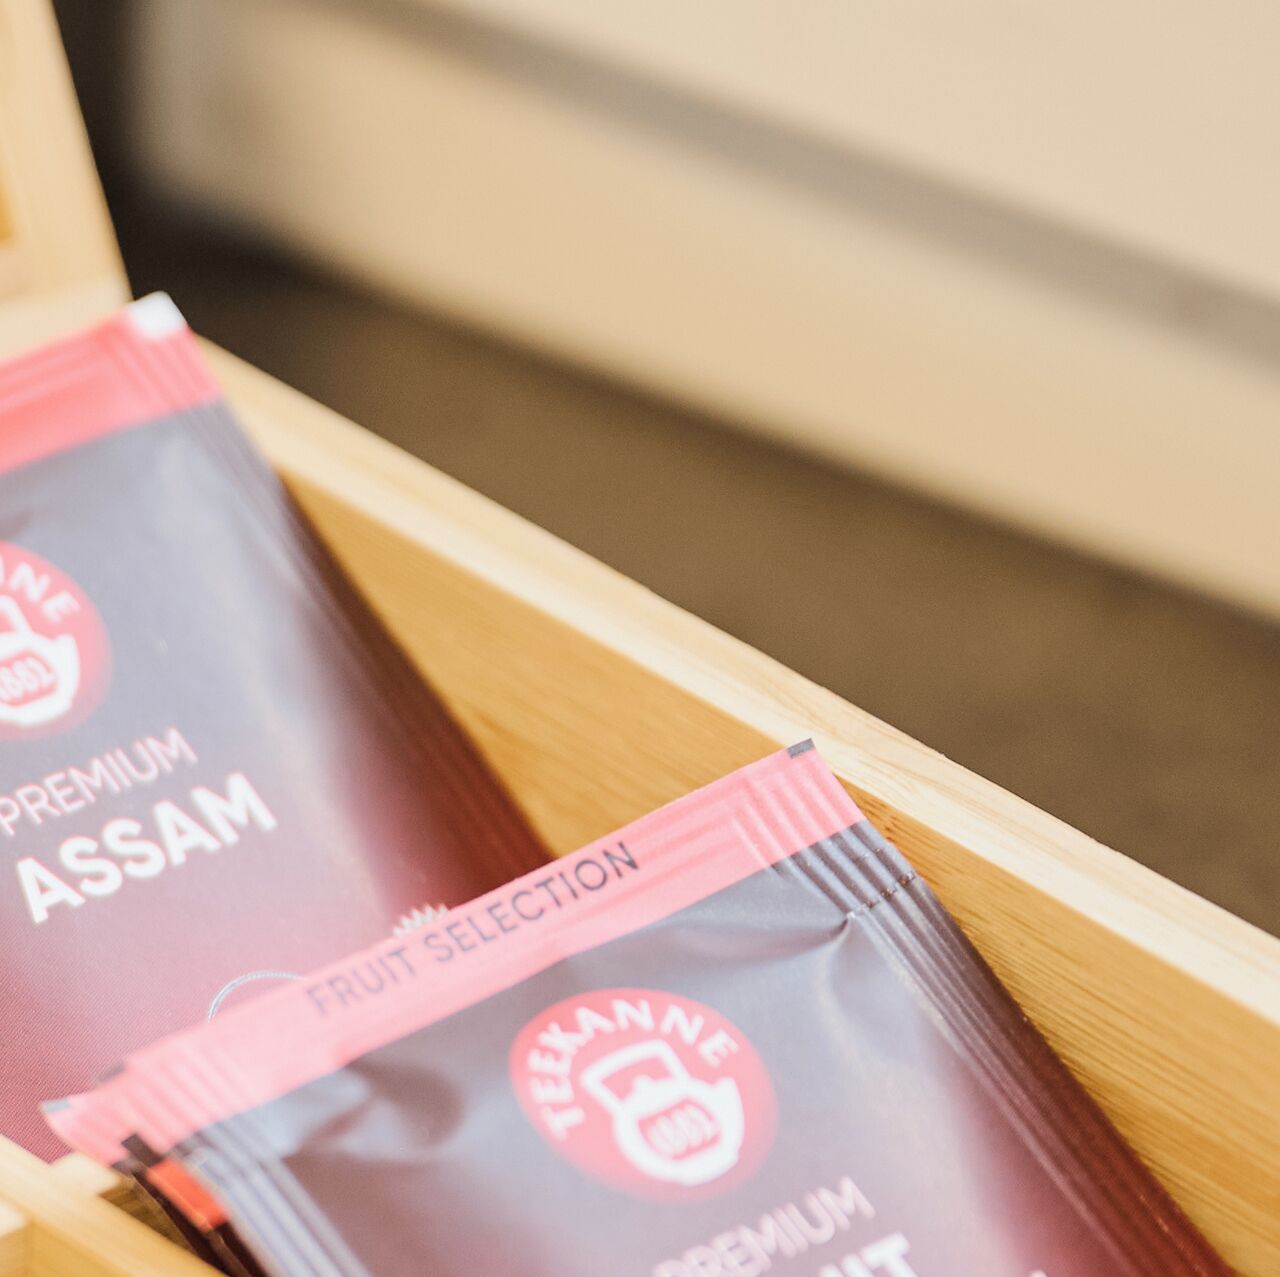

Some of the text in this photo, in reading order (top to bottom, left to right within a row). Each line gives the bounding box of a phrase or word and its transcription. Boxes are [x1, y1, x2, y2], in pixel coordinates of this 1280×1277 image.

[15, 771, 279, 925] ASSAM
[305, 840, 640, 1017] FRUIT SELECTION
[527, 998, 739, 1142] TEEKANNE
